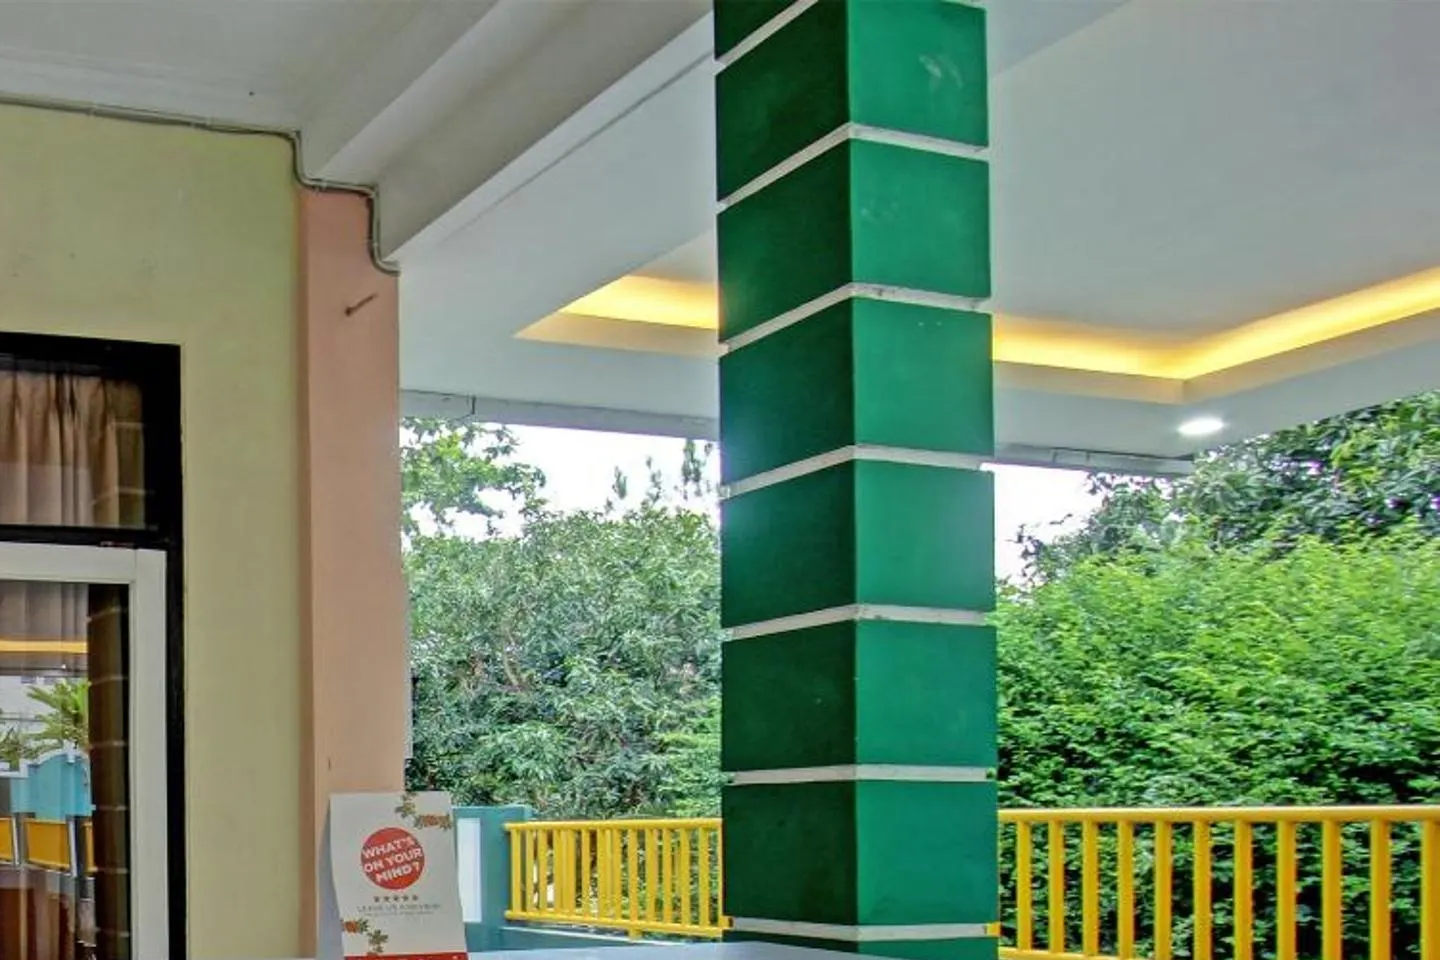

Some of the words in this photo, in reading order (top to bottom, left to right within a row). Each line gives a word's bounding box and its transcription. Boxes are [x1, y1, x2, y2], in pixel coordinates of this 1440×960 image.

[362, 836, 416, 859] WHAT'S
[364, 858, 385, 873] ON
[385, 848, 422, 867] YOUR
[375, 861, 420, 882] MIND?
